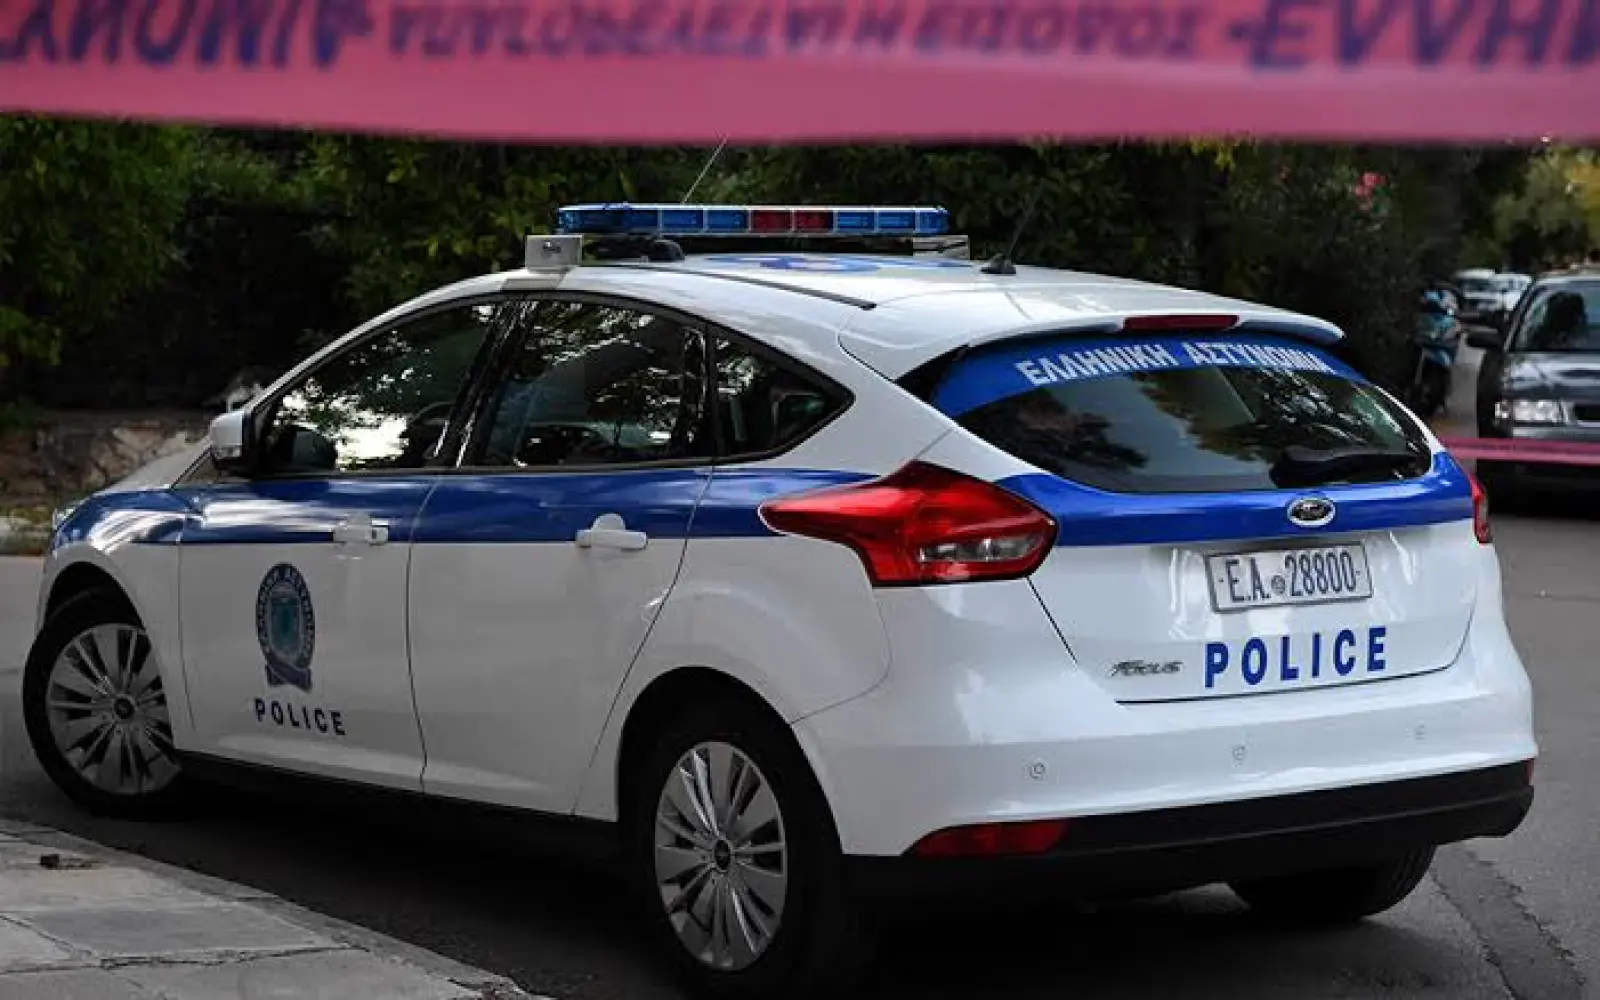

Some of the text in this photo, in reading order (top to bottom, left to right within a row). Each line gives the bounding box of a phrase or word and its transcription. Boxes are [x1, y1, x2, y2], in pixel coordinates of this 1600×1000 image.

[1013, 344, 1181, 386] ΕΛΛΗΝΙΚΗ
[1285, 551, 1357, 597] 28800
[1205, 625, 1387, 688] POLICE
[254, 698, 346, 736] POLICE
